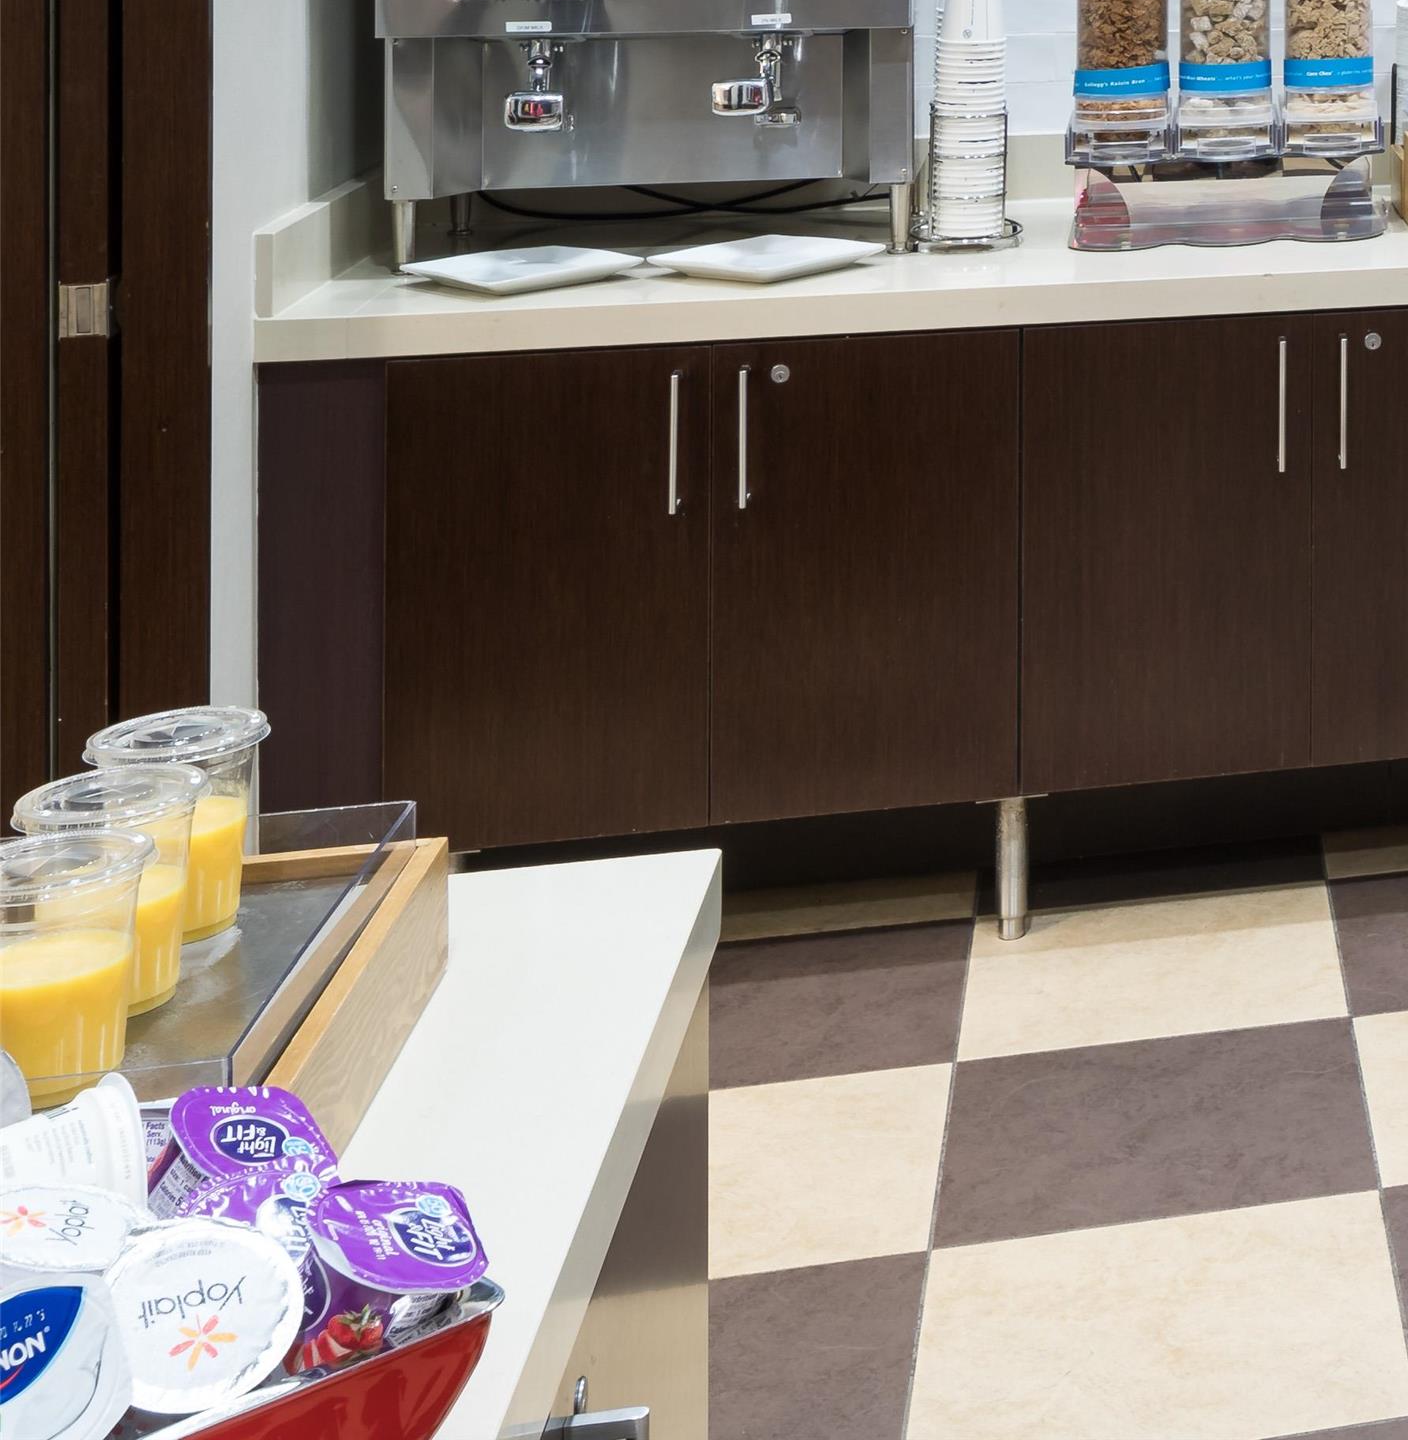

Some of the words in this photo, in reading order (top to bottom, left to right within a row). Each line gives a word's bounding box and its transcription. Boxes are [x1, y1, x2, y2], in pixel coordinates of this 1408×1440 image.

[209, 1102, 256, 1116] original
[146, 1122, 164, 1130] Facts
[221, 1124, 256, 1142] FIT
[237, 1136, 276, 1157] Light
[421, 1218, 455, 1251] Light
[138, 1275, 247, 1329] Yoplait
